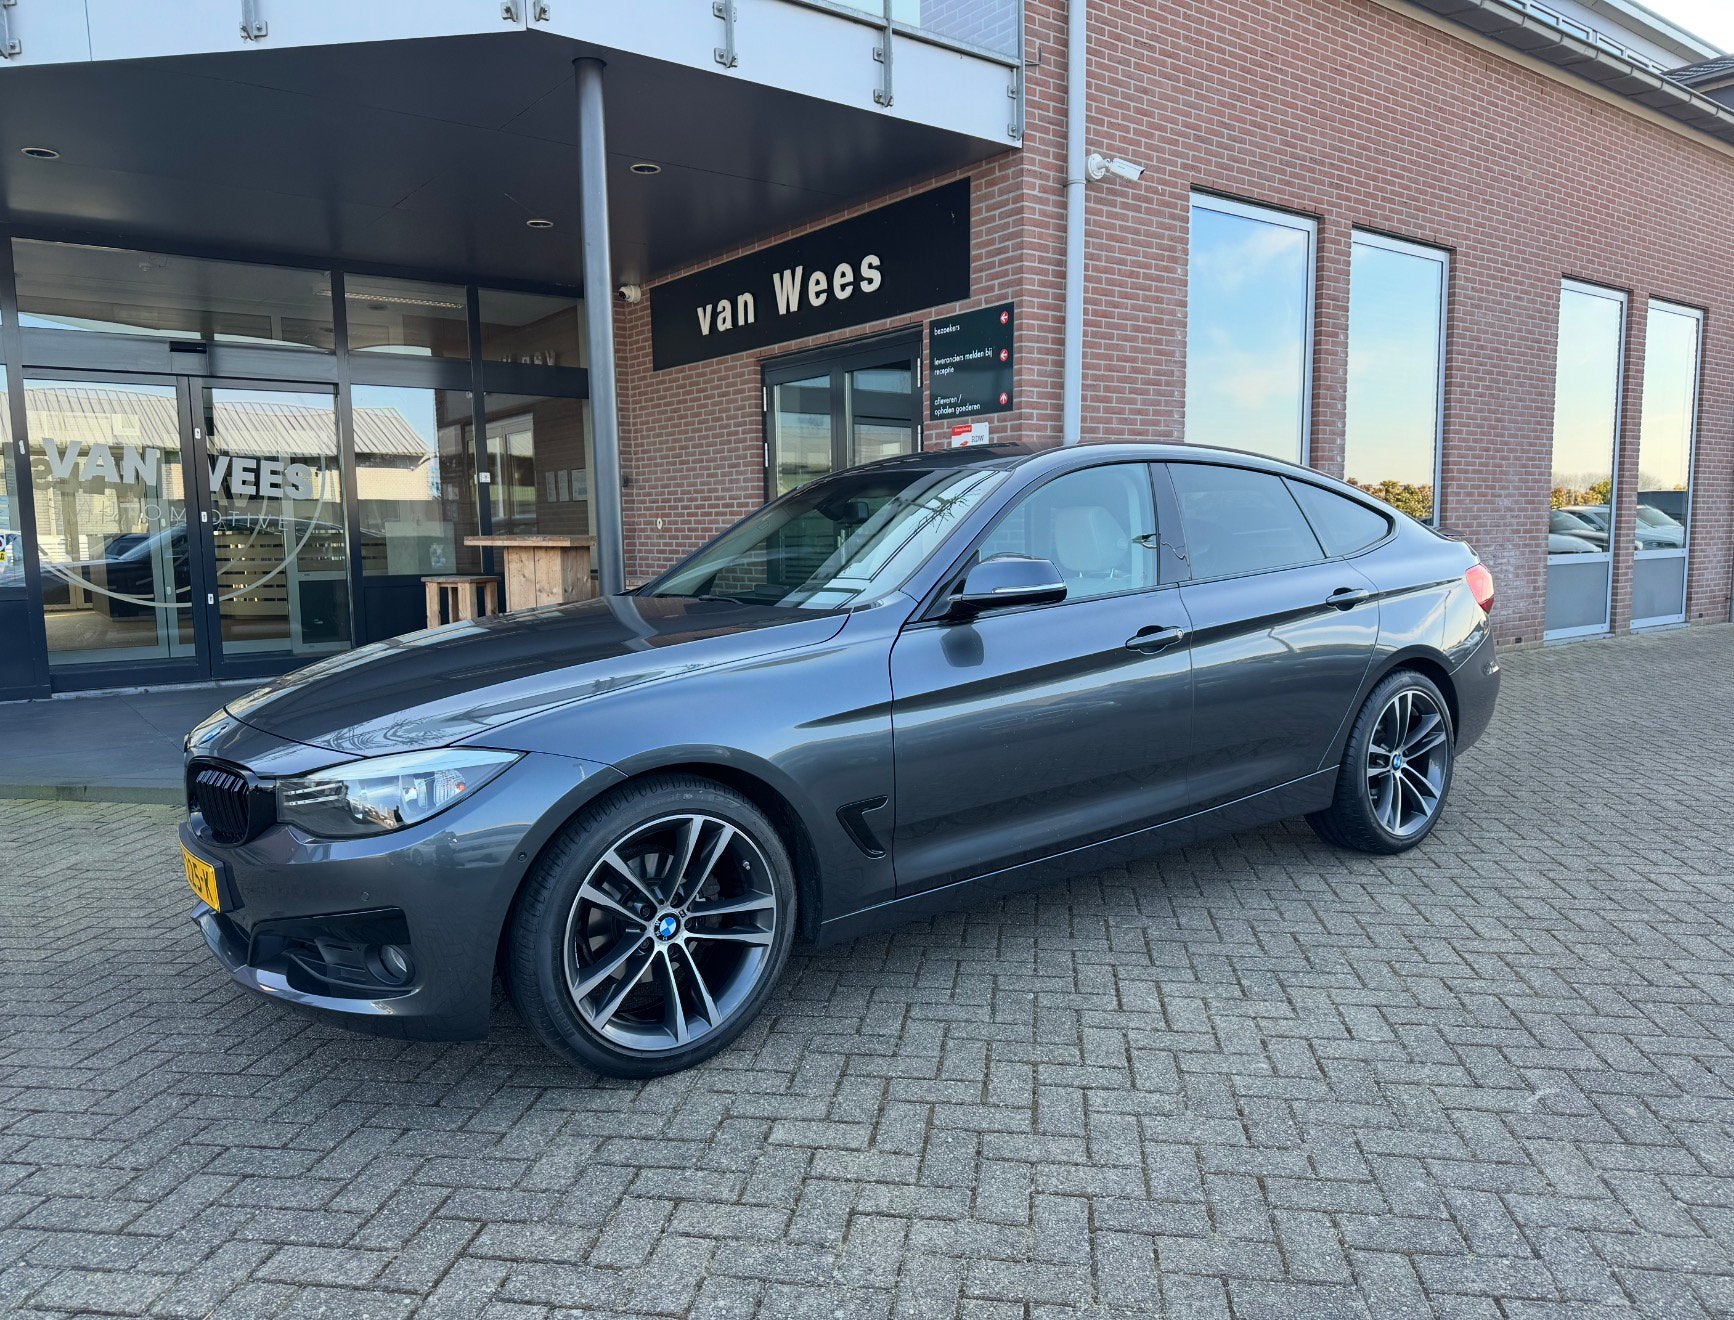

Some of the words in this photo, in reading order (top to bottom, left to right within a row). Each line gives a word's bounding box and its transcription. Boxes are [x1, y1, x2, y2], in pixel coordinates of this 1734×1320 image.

[697, 292, 755, 336] van
[772, 254, 882, 315] Wees
[934, 323, 960, 336] bezoekers
[934, 354, 964, 366] leveranciers
[964, 349, 984, 360] melden
[985, 347, 993, 359] bij
[934, 366, 955, 376] receptie
[934, 396, 957, 406] afleveren
[934, 405, 955, 417] ophalen
[955, 403, 981, 415] goederen
[971, 434, 985, 443] RDW
[42, 437, 158, 486] VAN
